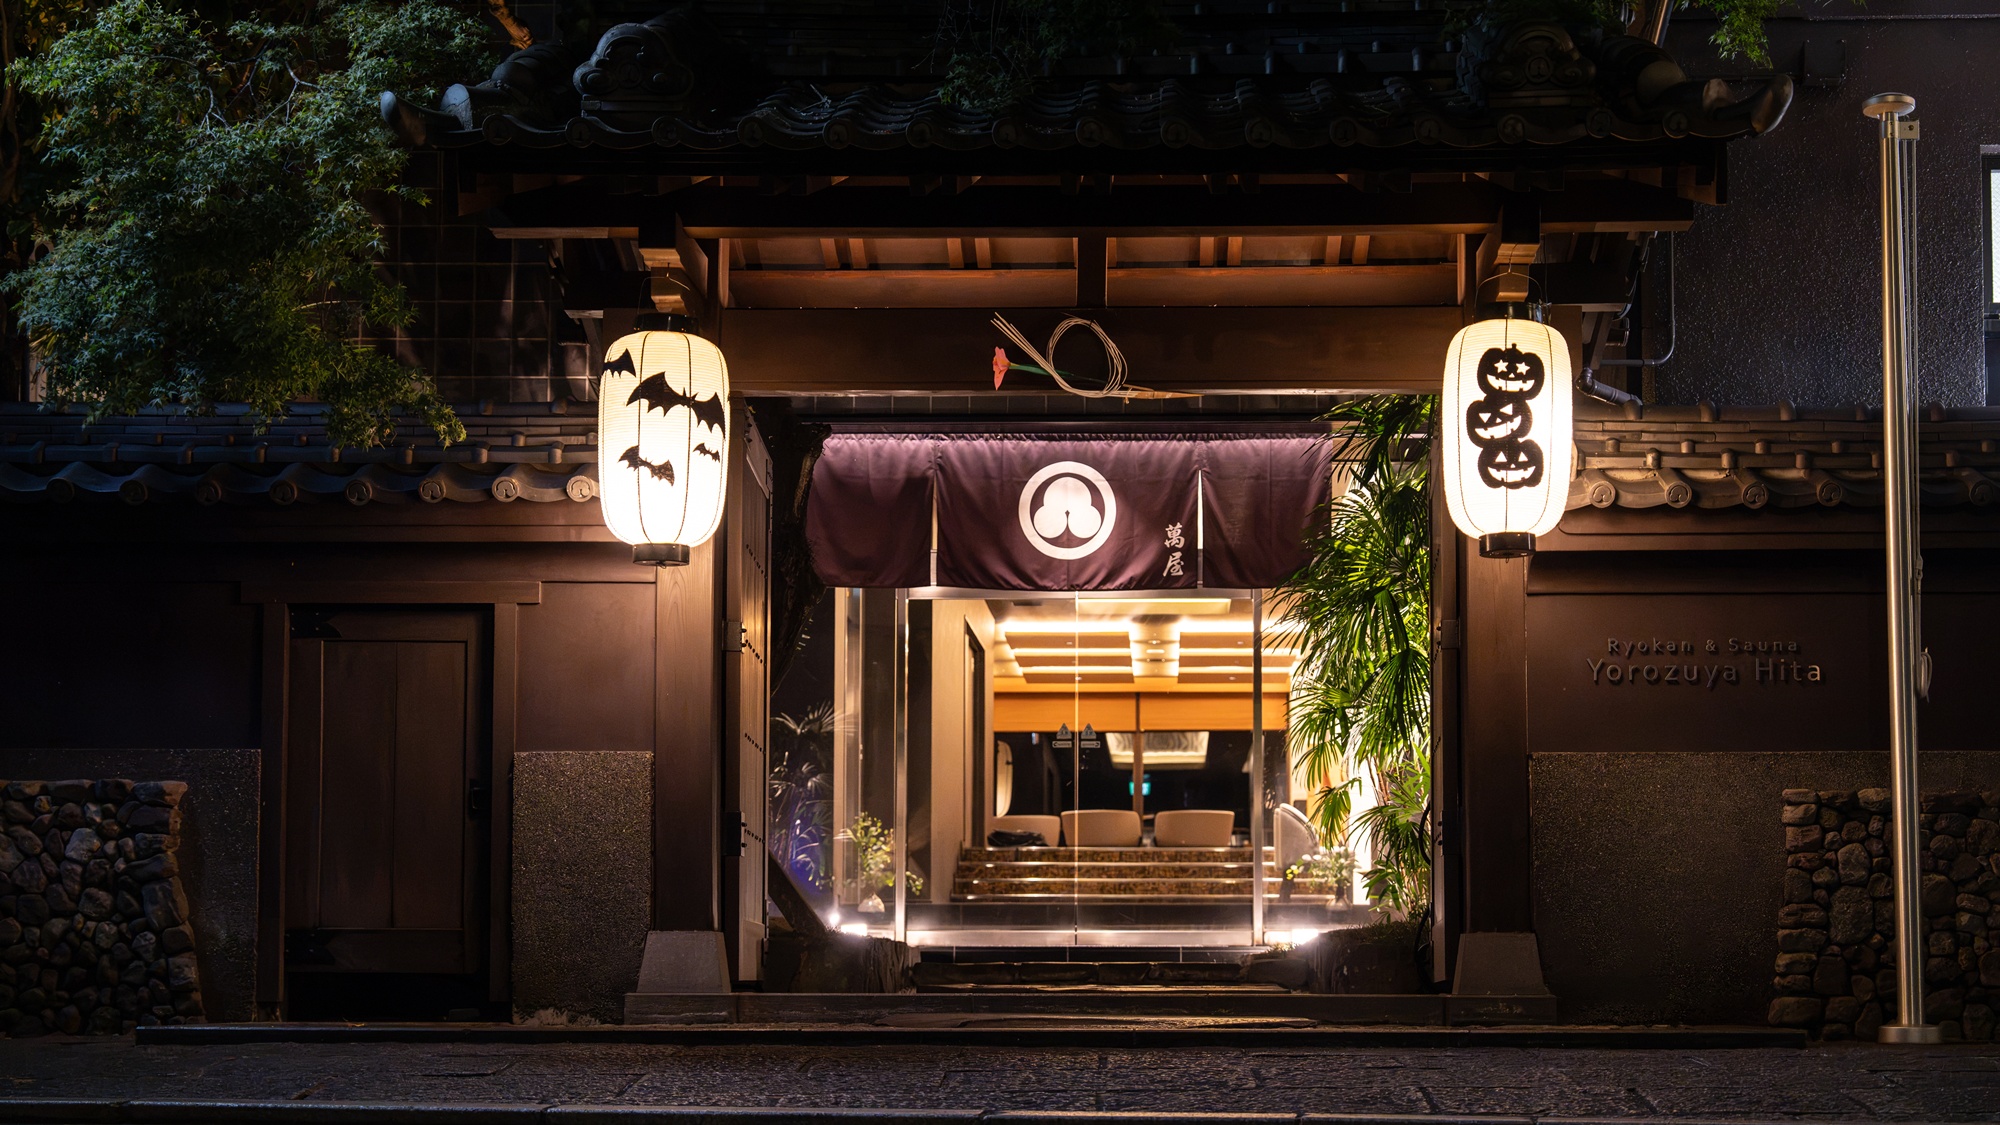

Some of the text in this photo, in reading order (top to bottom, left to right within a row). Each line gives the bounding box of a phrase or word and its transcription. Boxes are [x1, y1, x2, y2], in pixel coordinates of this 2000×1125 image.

[1163, 522, 1185, 577] 萬屋
[1607, 637, 1799, 656] Ryokan & Sauna
[1586, 658, 1822, 688] Yorozuya Hita
